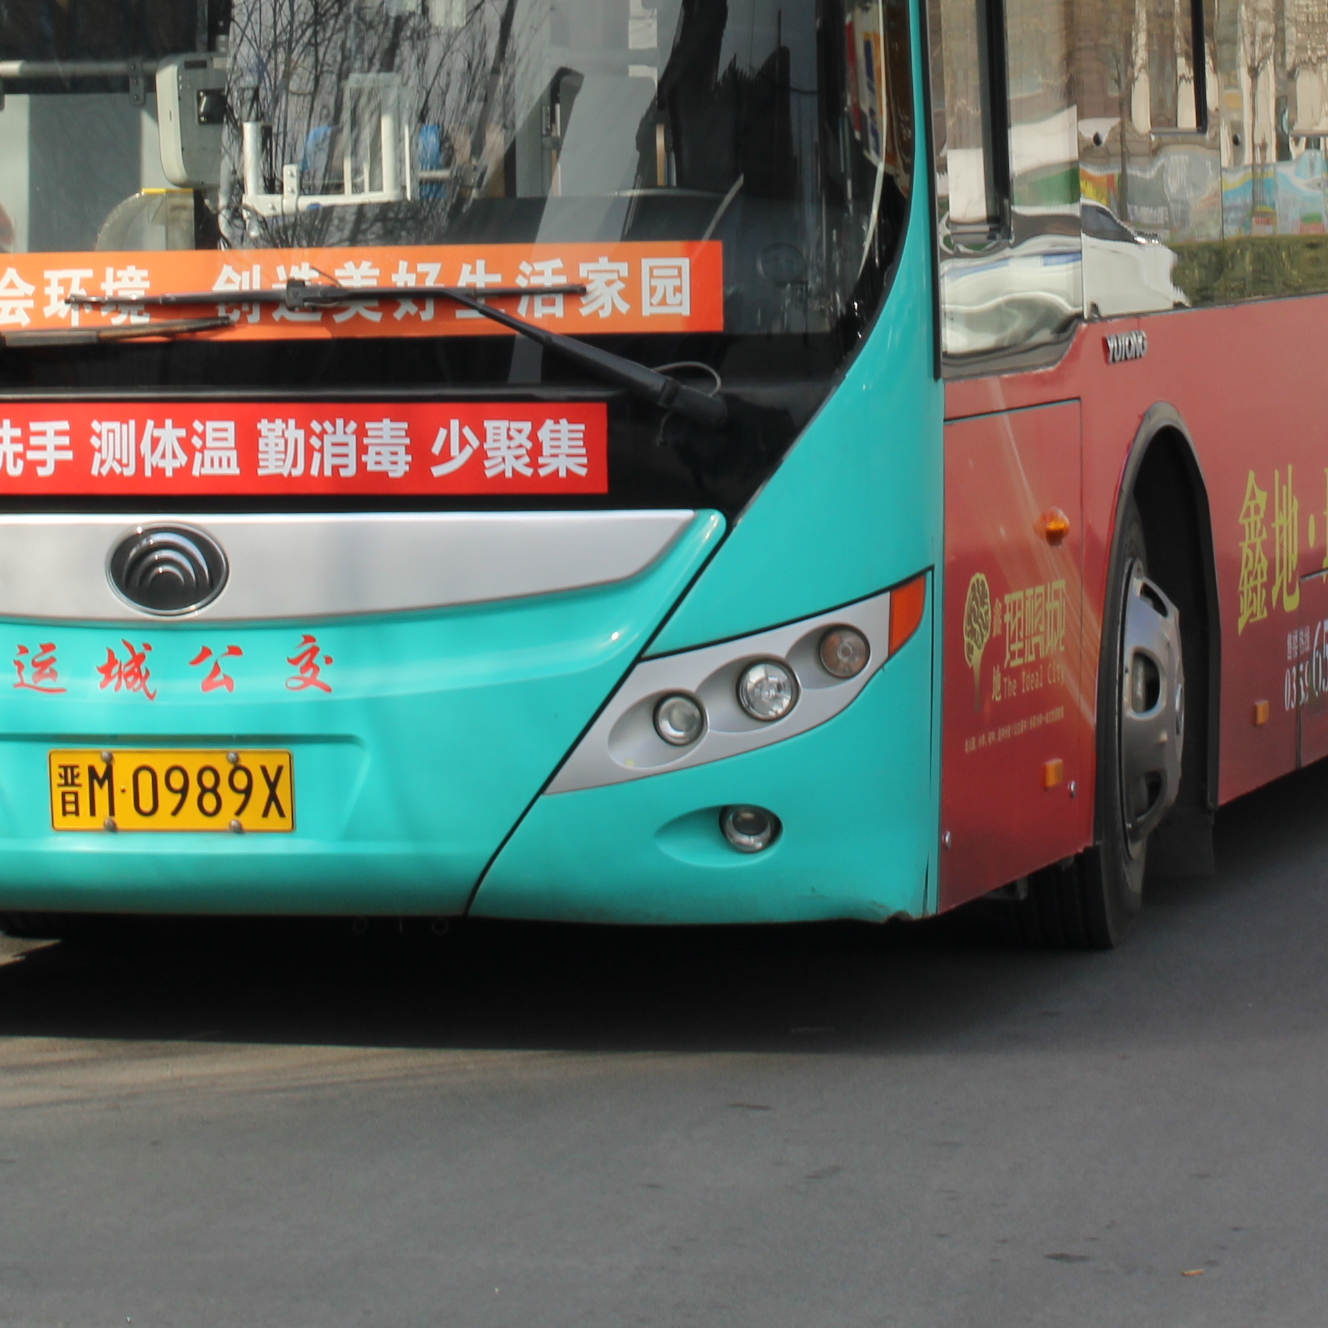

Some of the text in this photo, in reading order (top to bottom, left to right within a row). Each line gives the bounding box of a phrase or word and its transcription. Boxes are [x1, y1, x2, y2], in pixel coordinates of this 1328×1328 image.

[212, 255, 691, 320] 创造美好生活家园
[1106, 330, 1148, 364] YUTONG
[88, 418, 241, 478] 测体温
[256, 418, 412, 478] 勤消毒
[429, 418, 588, 478] 少聚集
[13, 634, 336, 700] 运城公交
[1004, 674, 1018, 700] The
[1022, 663, 1044, 694] Ideal
